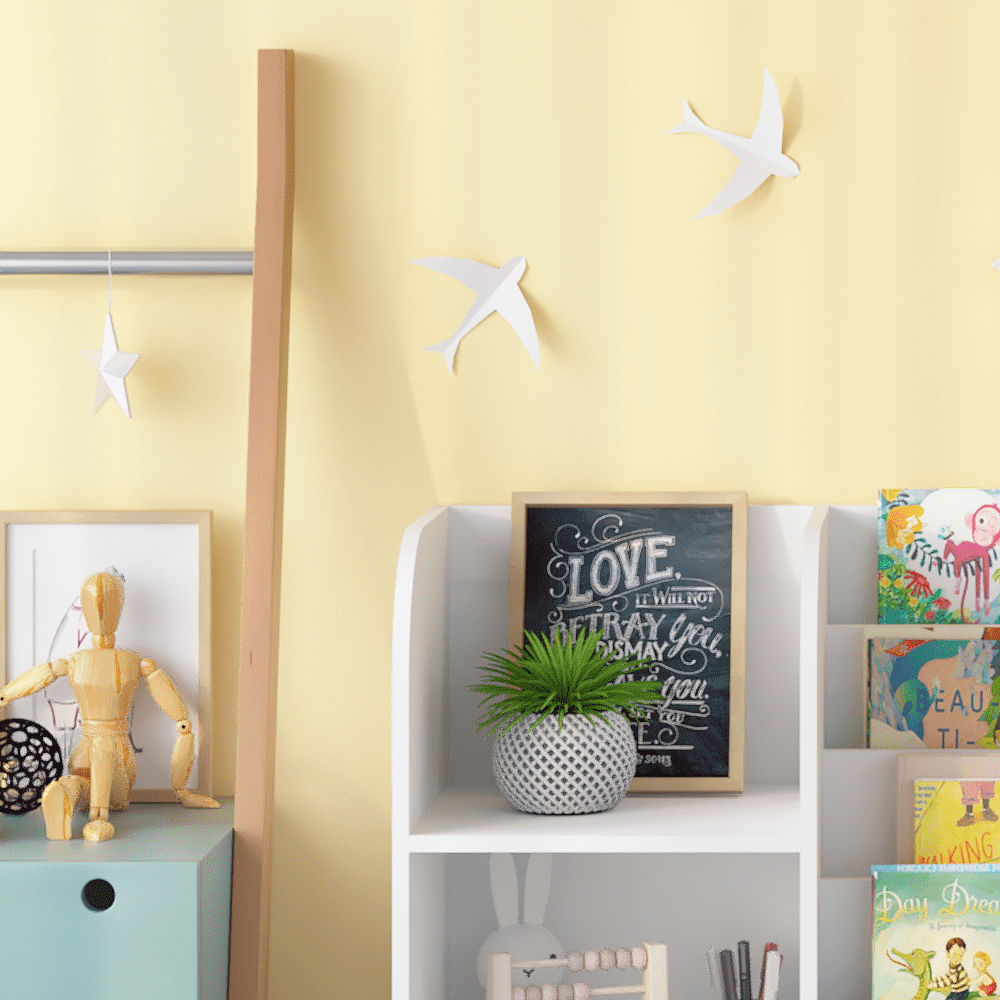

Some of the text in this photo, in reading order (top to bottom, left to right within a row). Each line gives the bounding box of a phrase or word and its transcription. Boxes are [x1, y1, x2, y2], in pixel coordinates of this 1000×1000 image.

[635, 593, 648, 605] IT
[686, 591, 716, 606] NOT
[874, 886, 928, 927] Day
